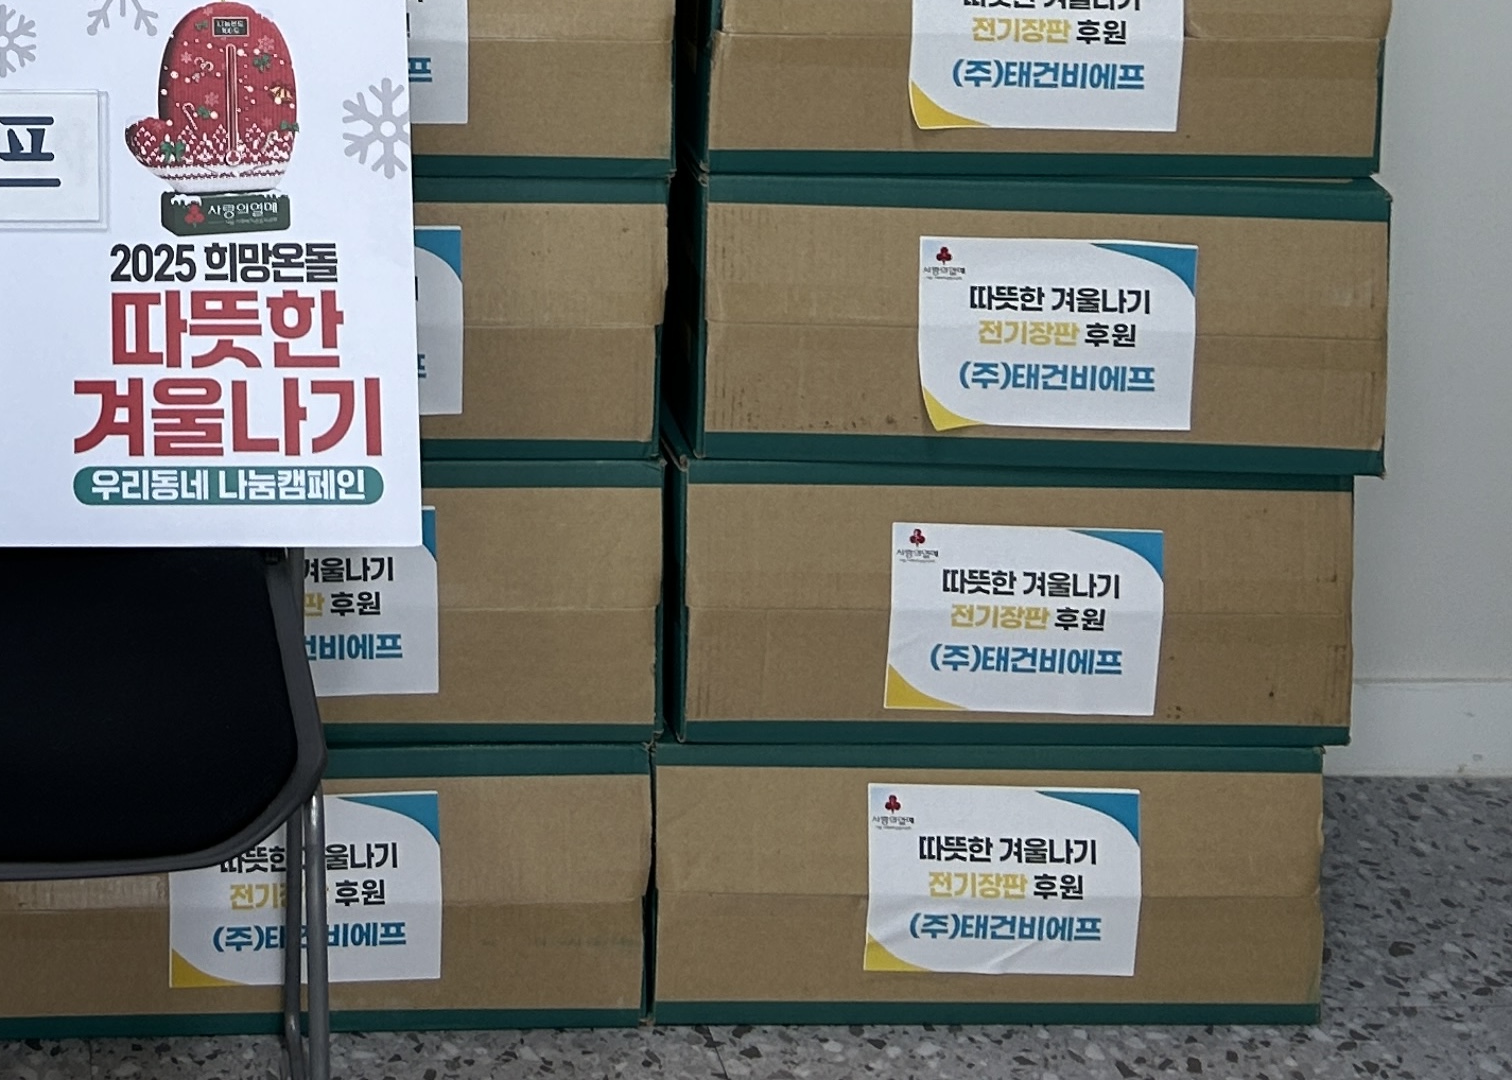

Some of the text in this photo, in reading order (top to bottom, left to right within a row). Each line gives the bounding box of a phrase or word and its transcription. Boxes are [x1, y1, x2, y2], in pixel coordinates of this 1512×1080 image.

[973, 17, 1127, 45] 전기장판 후원
[951, 59, 1145, 90] (주)태건비에프
[207, 201, 278, 219] 사랑의열매
[110, 242, 338, 283] 2025 희망온돌
[969, 285, 1150, 315] 따뜻한 겨울나기
[111, 289, 345, 369] 따뜻한
[979, 321, 1136, 348] 전기장판 후원
[959, 361, 1154, 392] (주)태건비에프
[74, 377, 383, 457] 겨울나기
[91, 469, 366, 501] 우리동네 나눔캠페인
[942, 569, 1120, 600] 따뜻한 겨울나기
[330, 591, 381, 617] 후원
[950, 605, 1106, 632] 전기장판 후원
[930, 644, 1122, 675] (주)태건비에프
[324, 841, 399, 871] 울나기
[919, 835, 1097, 866] 따뜻한 겨울나기
[334, 879, 386, 907] 후원
[930, 873, 1084, 901] 전기장판 후원
[909, 913, 1100, 940] (주)태건비에프
